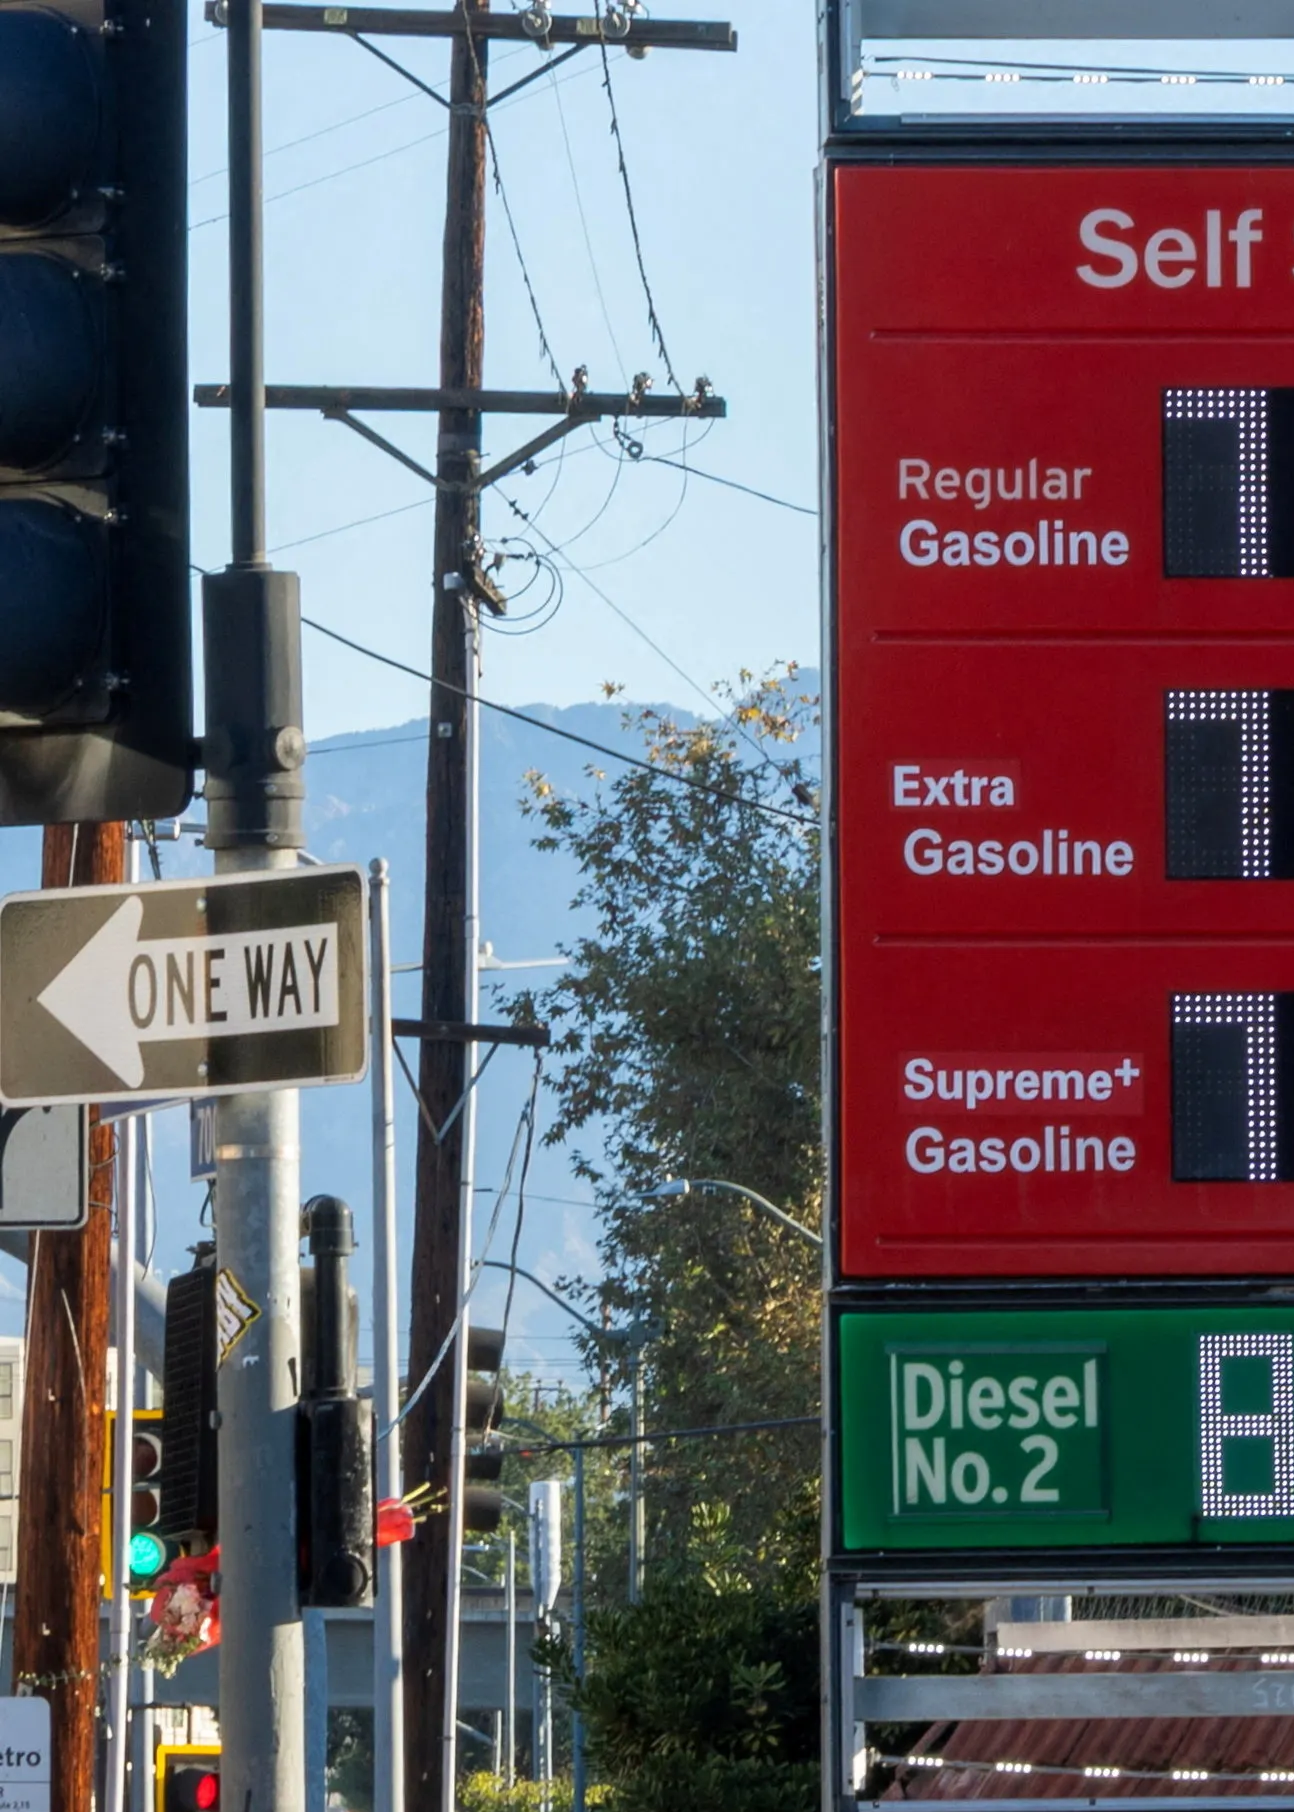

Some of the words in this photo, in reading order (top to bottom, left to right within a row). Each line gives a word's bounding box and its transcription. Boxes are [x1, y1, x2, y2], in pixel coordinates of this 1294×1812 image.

[1076, 208, 1264, 290] Self
[899, 458, 1093, 511] Regular
[899, 519, 1131, 568] Gasoline
[892, 766, 1016, 808] Extra
[902, 829, 1135, 877] Gasoline
[128, 950, 228, 1030] ONE
[244, 937, 328, 1020] WAY
[904, 1126, 1138, 1175] Gasoline
[903, 1358, 1098, 1431] Diesel
[0, 1745, 41, 1768] tro
